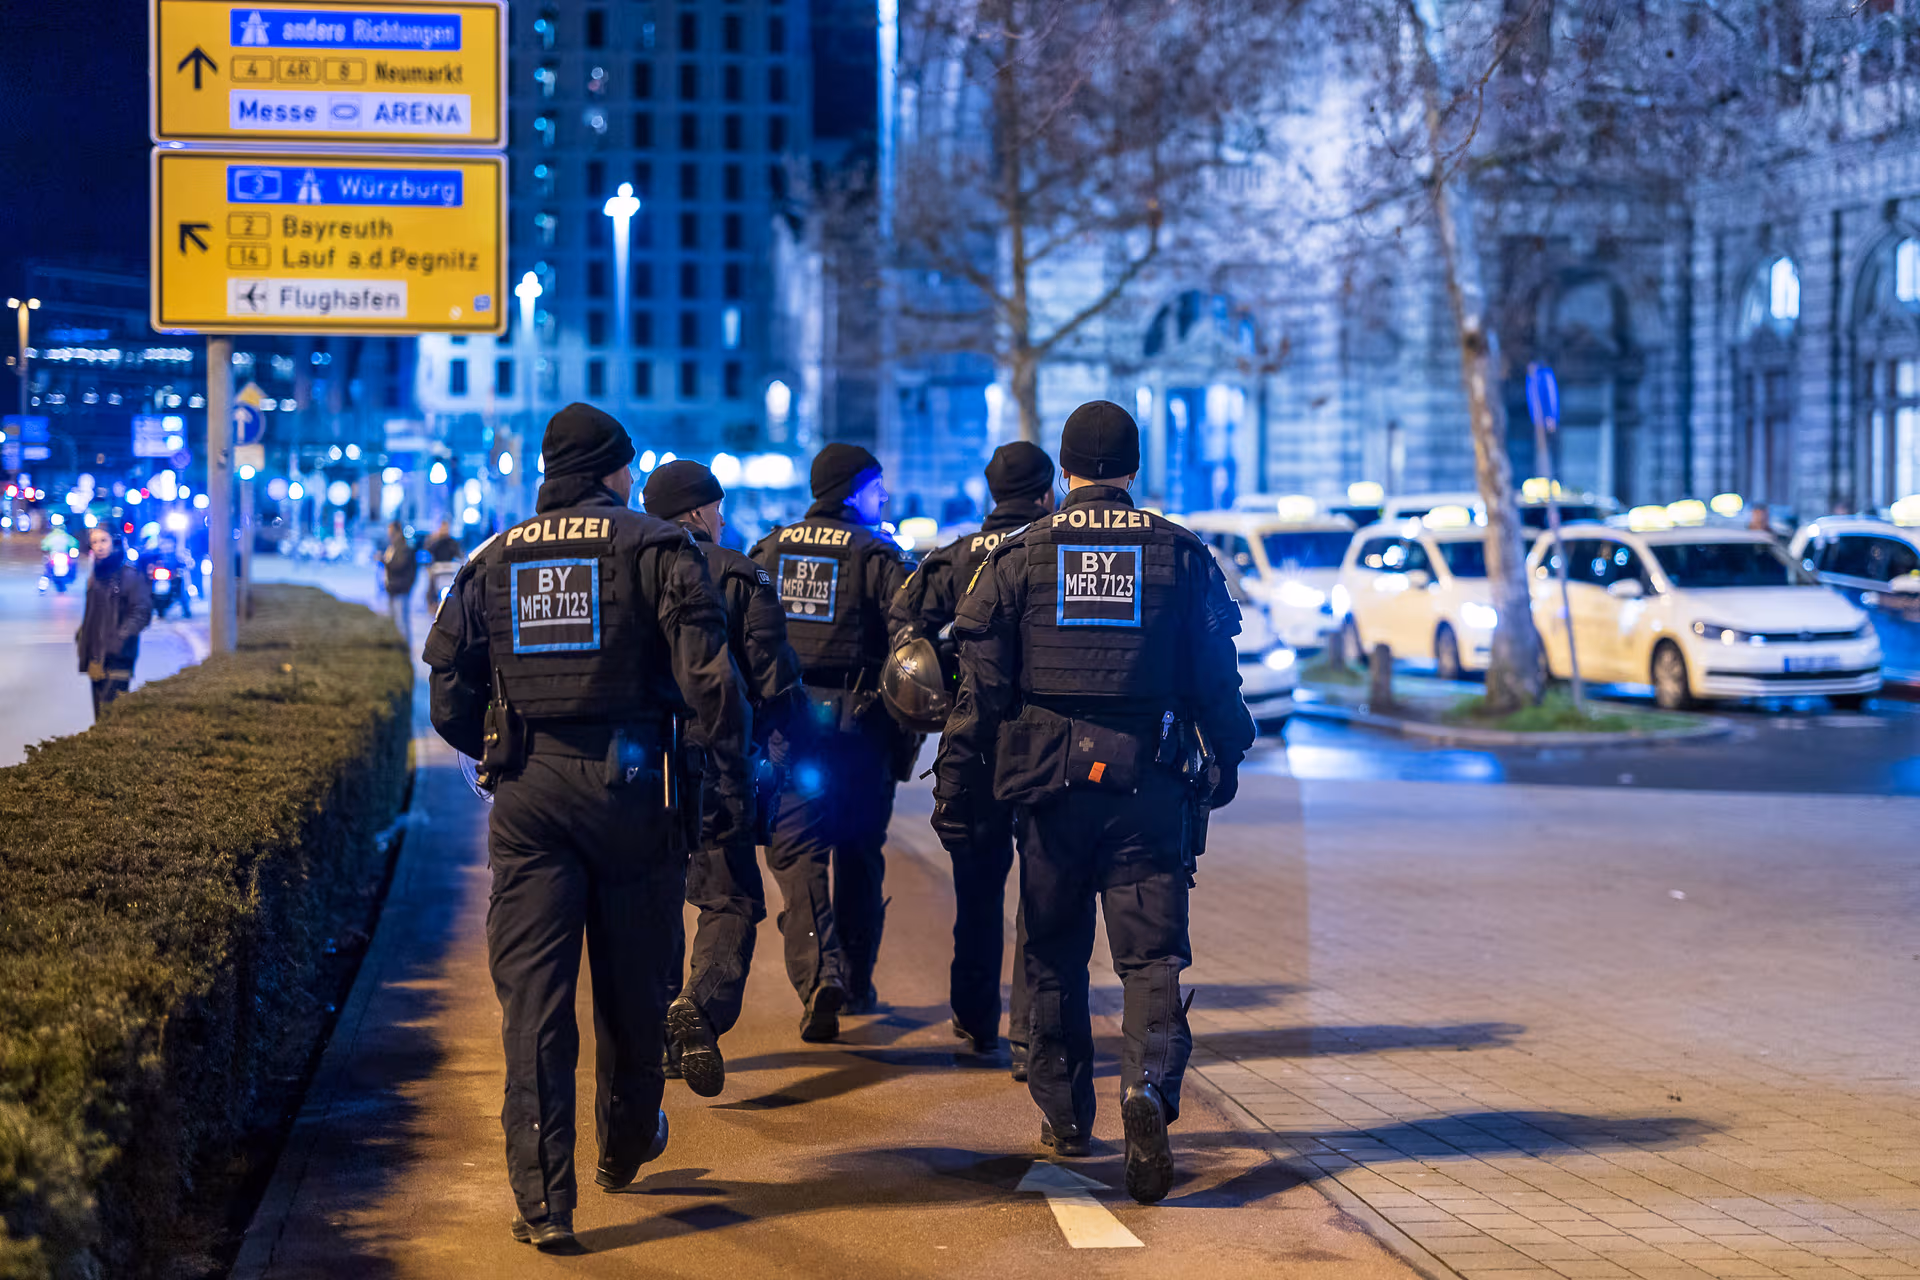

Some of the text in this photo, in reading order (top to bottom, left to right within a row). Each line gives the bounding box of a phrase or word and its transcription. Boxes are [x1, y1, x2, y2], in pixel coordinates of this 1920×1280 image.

[282, 18, 455, 49] andere Richtungen
[375, 61, 463, 83] Neumarkt
[239, 100, 317, 122] Messe
[374, 102, 462, 125] ARENA
[338, 176, 456, 206] Würzburg
[282, 214, 394, 241] Bayreuth
[282, 246, 336, 269] Lauf
[279, 287, 401, 315] Flughafen
[1052, 509, 1150, 529] POLIZEI
[505, 517, 610, 546] POLIZEI
[779, 526, 852, 546] POLIZEI
[796, 562, 820, 580] BY
[1081, 553, 1117, 573] BY
[538, 567, 573, 592] BY
[782, 580, 829, 599] MFR 7123
[1065, 574, 1134, 597] MFR 7123
[520, 592, 589, 620] MFR 7123
